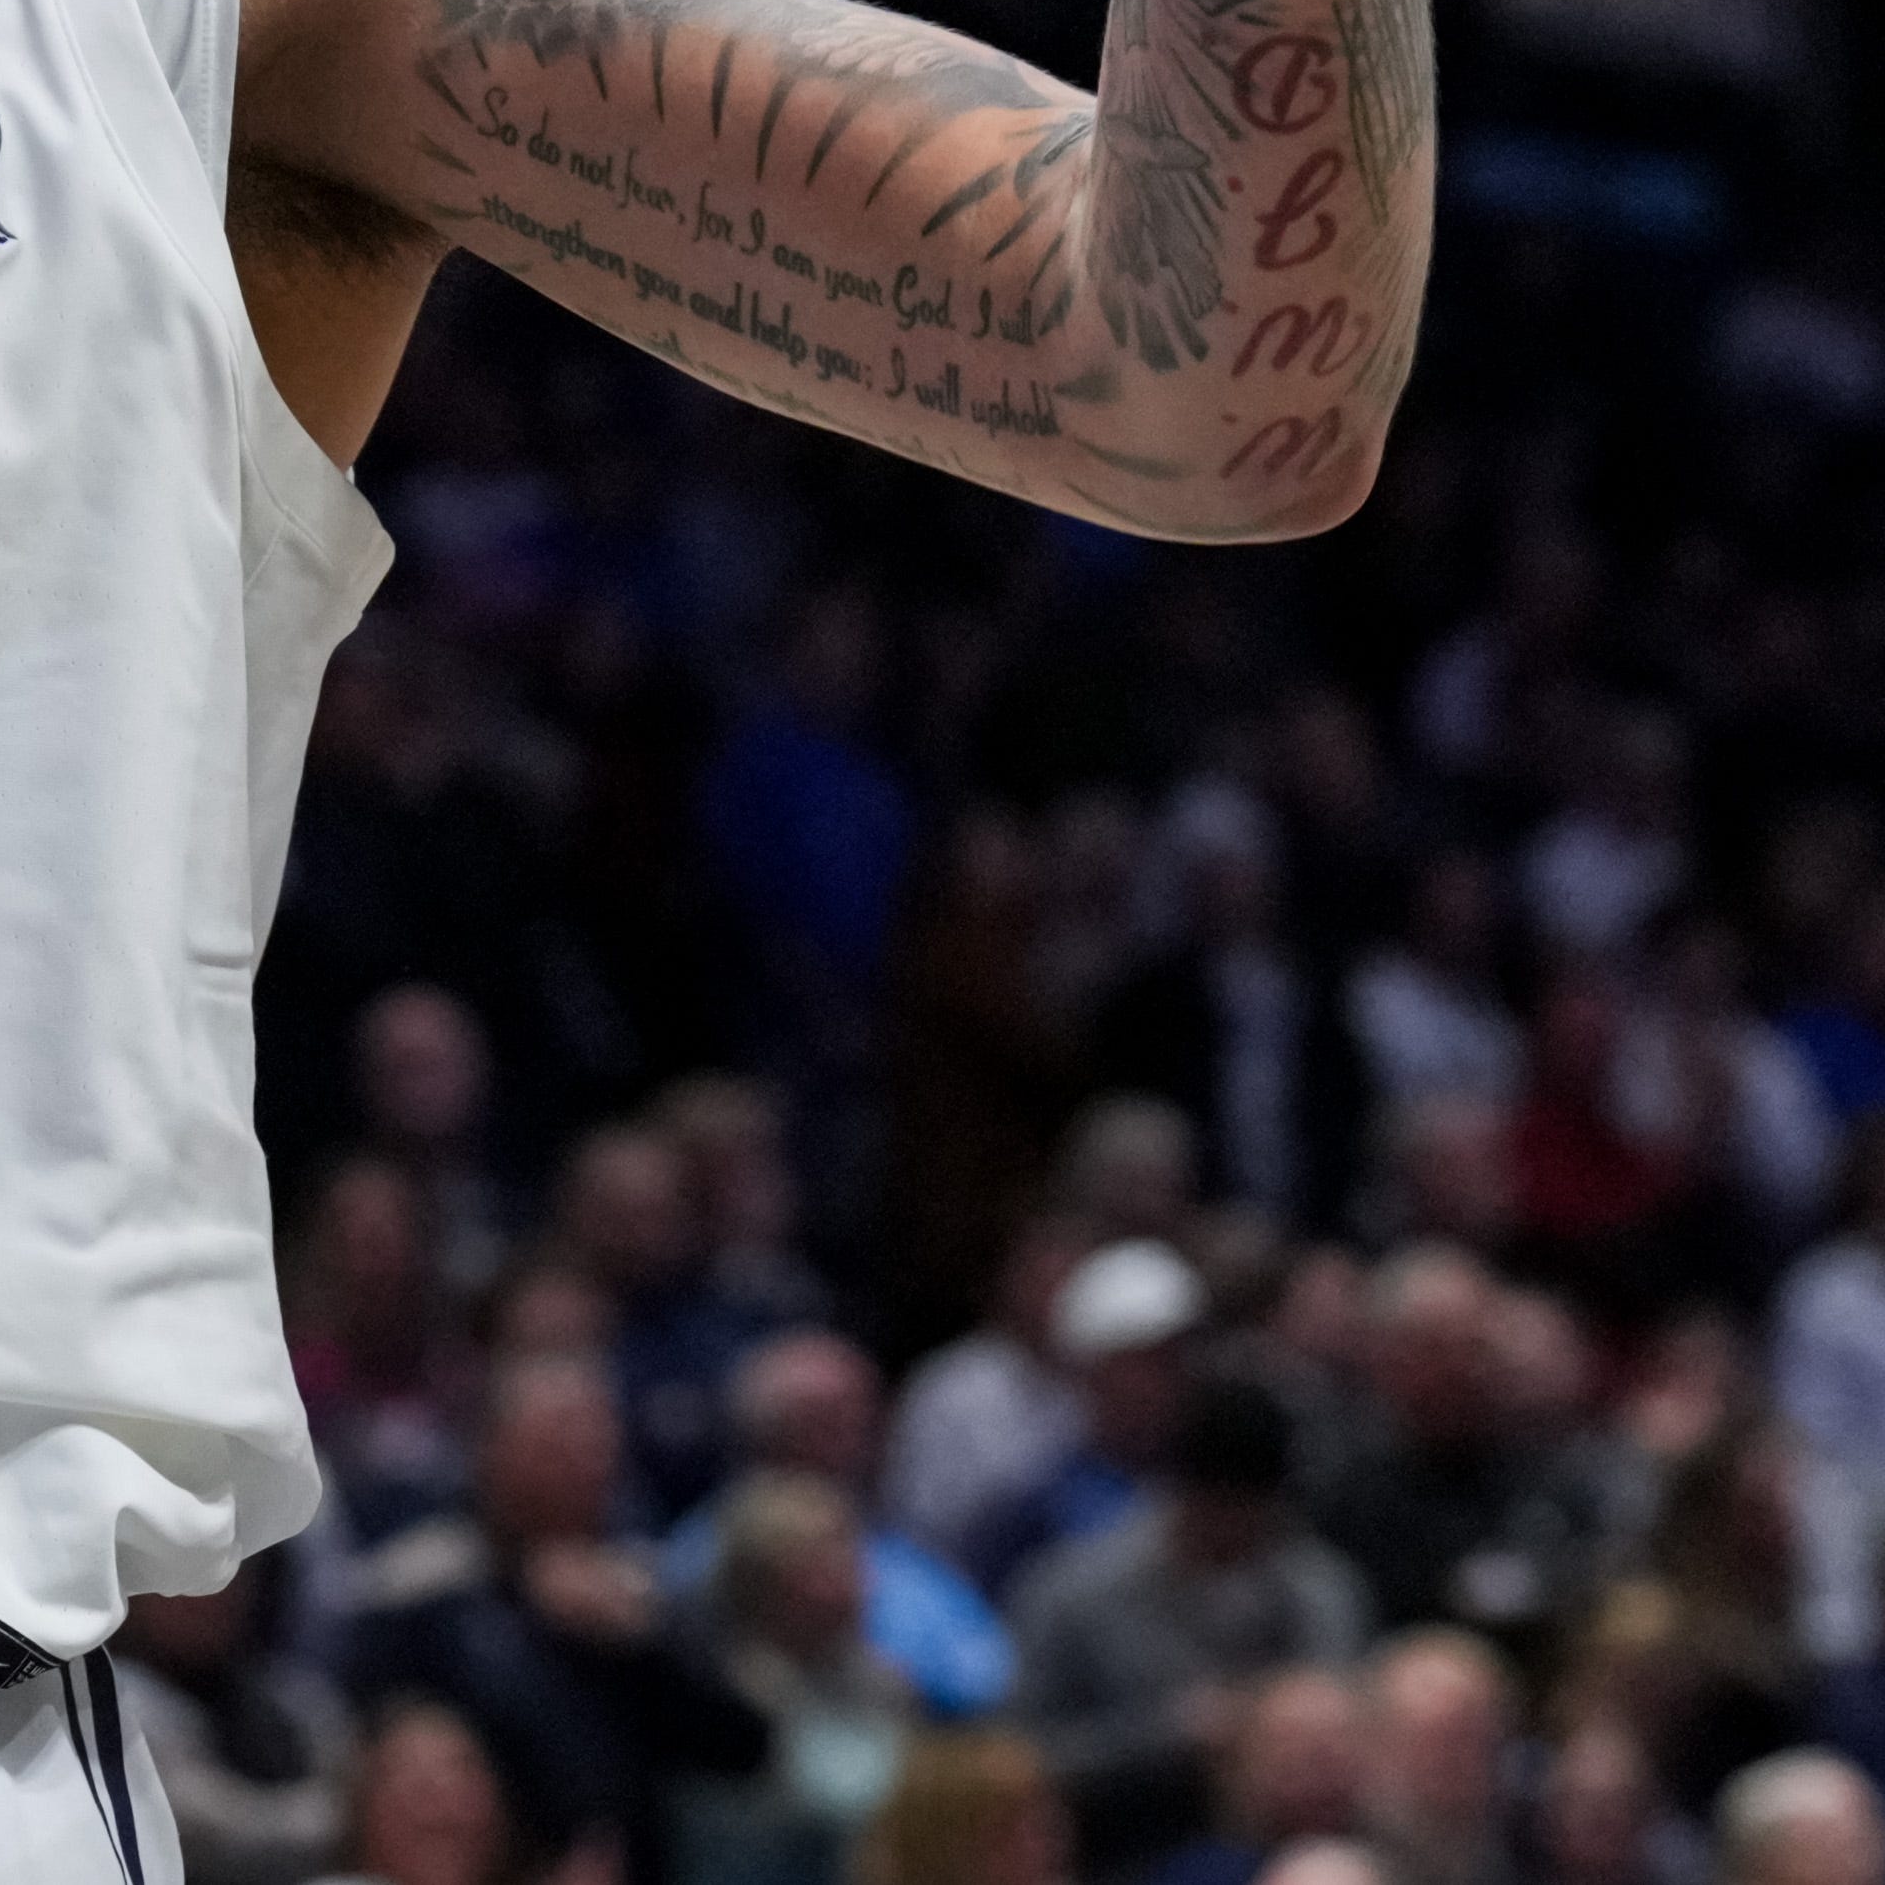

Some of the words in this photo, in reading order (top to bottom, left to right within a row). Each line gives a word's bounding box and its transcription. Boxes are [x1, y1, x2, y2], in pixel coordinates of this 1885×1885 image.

[477, 87, 519, 146] So
[527, 106, 561, 165] do
[570, 150, 615, 192] not
[694, 180, 733, 245] for
[740, 208, 765, 255] I
[773, 244, 817, 283] am
[825, 266, 883, 307] your
[971, 288, 991, 338] I
[634, 262, 683, 306] you
[689, 282, 744, 333] and
[750, 290, 807, 368] help
[885, 347, 905, 399] I
[914, 363, 960, 417] will
[971, 380, 1061, 438] uphold
